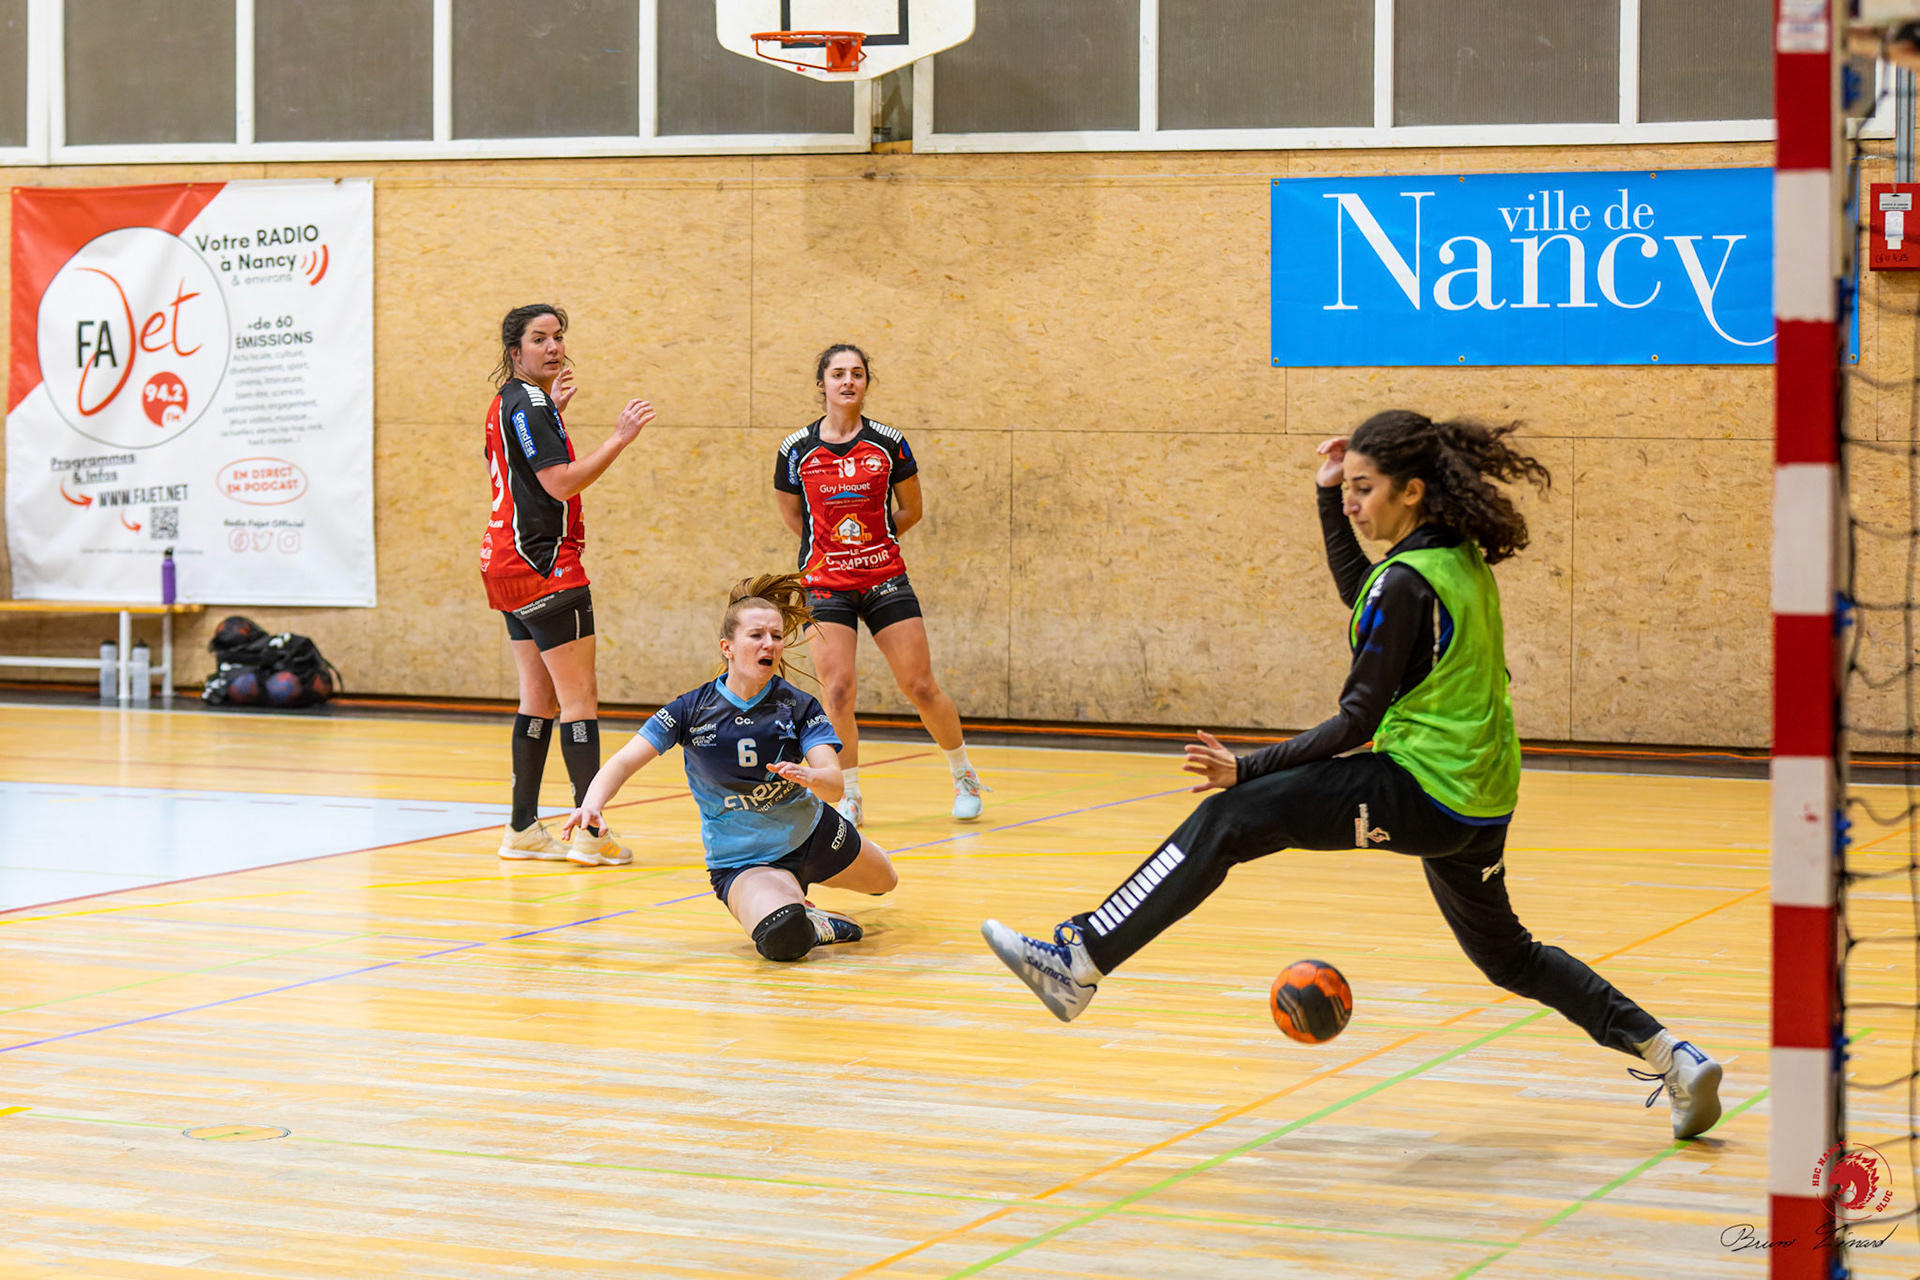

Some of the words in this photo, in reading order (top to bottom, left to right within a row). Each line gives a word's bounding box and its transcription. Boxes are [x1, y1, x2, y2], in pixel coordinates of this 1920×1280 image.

[1498, 190, 1591, 232] ville
[1603, 188, 1655, 231] de
[196, 234, 250, 252] Votre
[257, 224, 319, 248] RADIO
[220, 255, 232, 272] à
[238, 253, 297, 271] Nancy
[1322, 191, 1777, 346] Nancy
[231, 275, 240, 286] &
[245, 272, 293, 286] environs
[275, 315, 293, 328] 60
[235, 331, 313, 350] ÉMISSIONS
[51, 453, 135, 471] Programmes
[252, 466, 293, 479] DIRECT
[244, 479, 298, 492] PODCAST
[819, 484, 837, 494] Guy
[838, 482, 871, 493] Hoquet
[737, 738, 758, 768] 6
